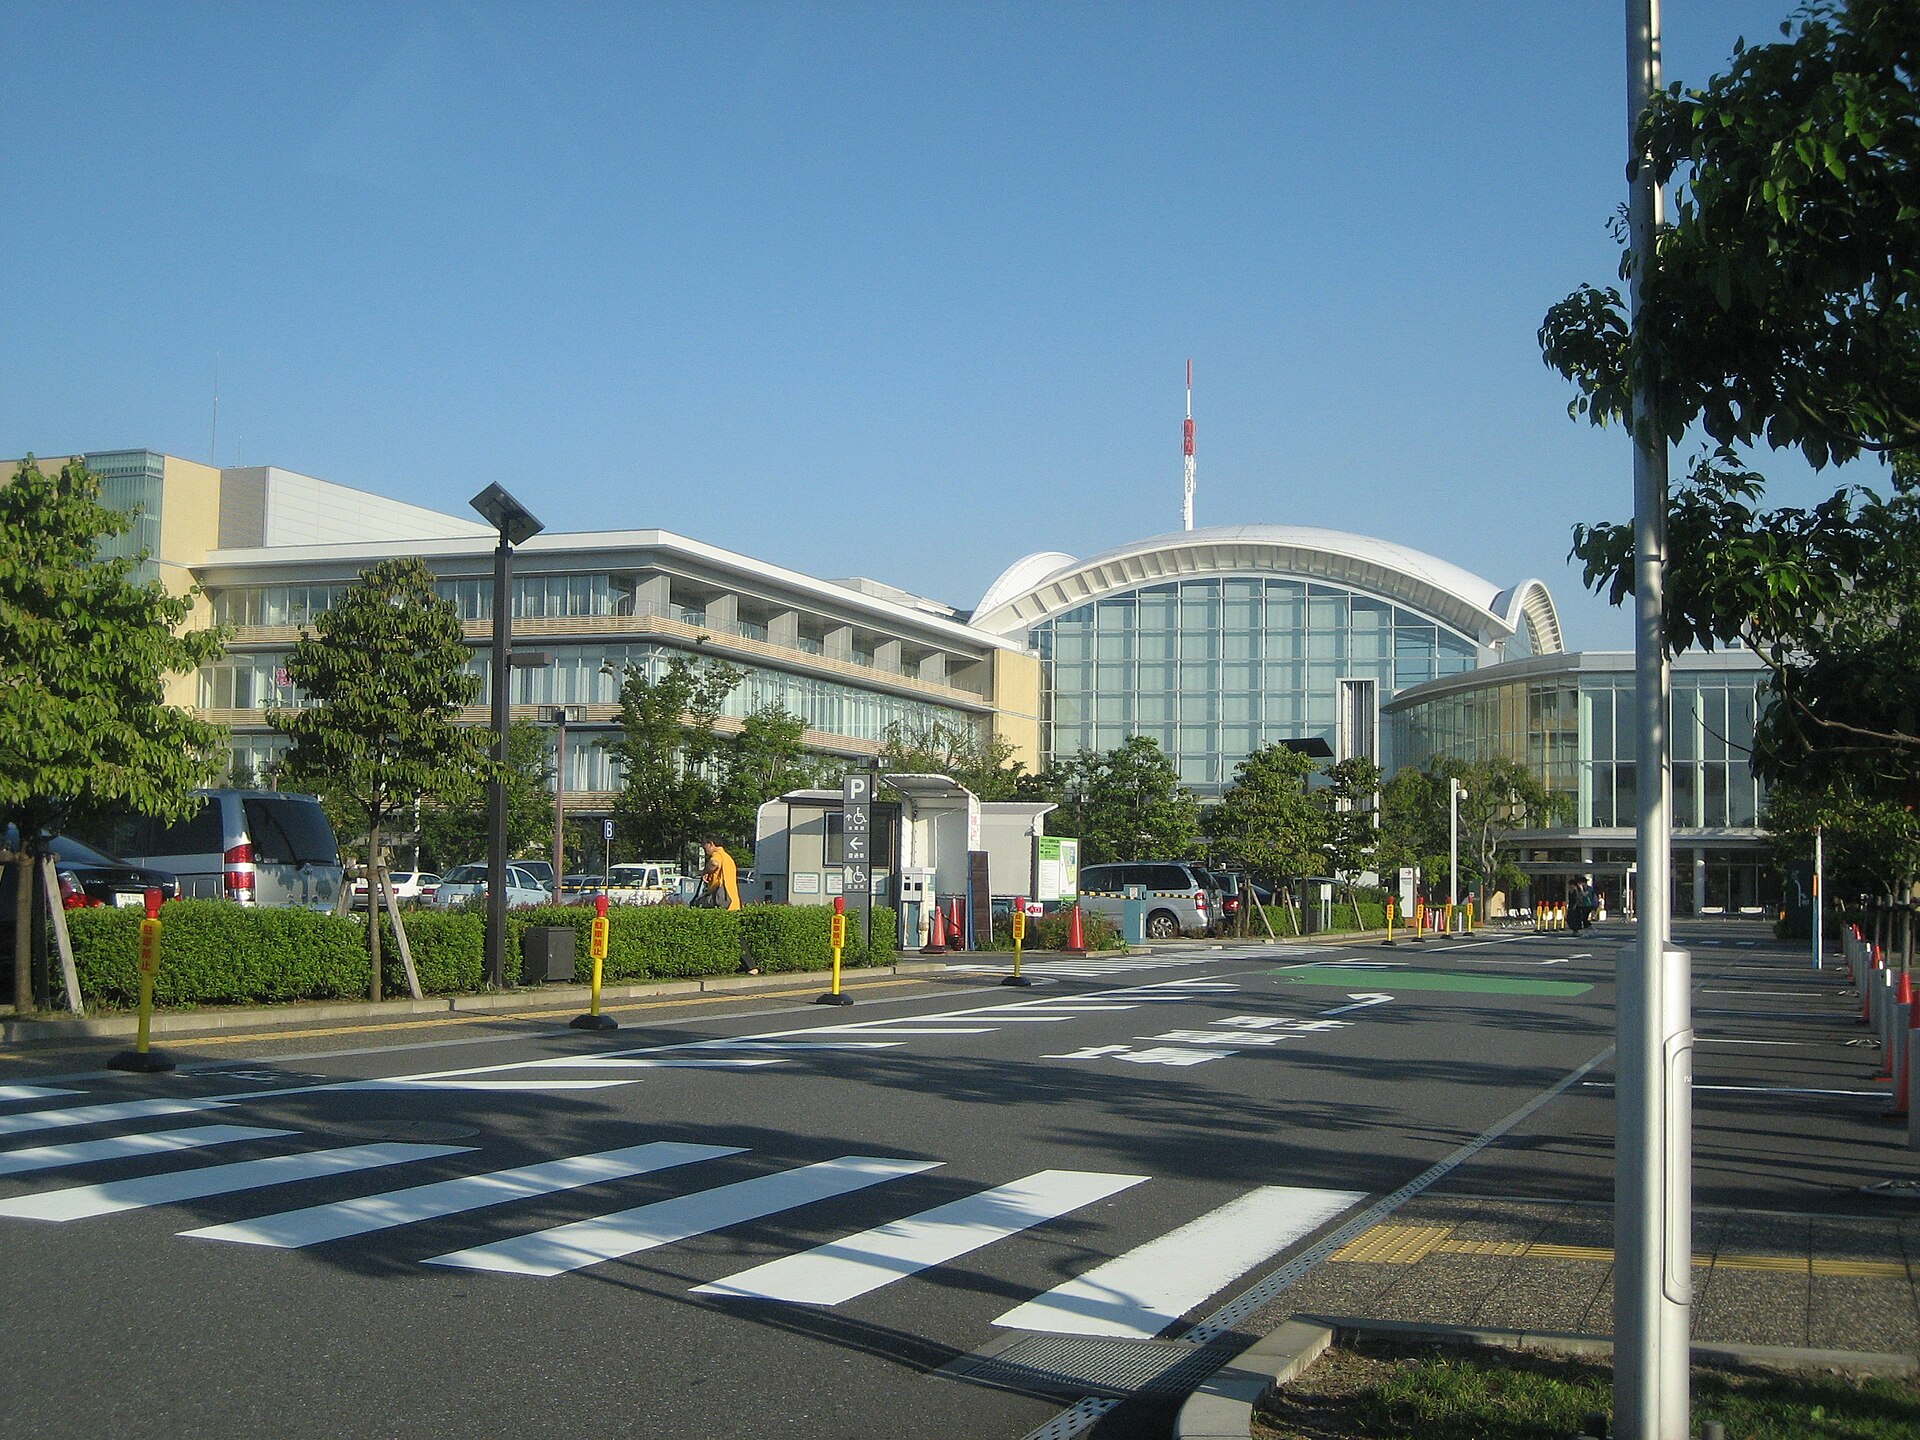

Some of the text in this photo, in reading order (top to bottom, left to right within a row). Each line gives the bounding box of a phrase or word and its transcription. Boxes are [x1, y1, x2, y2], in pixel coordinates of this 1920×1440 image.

[850, 778, 865, 799] P
[606, 821, 613, 837] B
[141, 924, 153, 971] 駐車禁止
[594, 921, 603, 956] 駐車禁止
